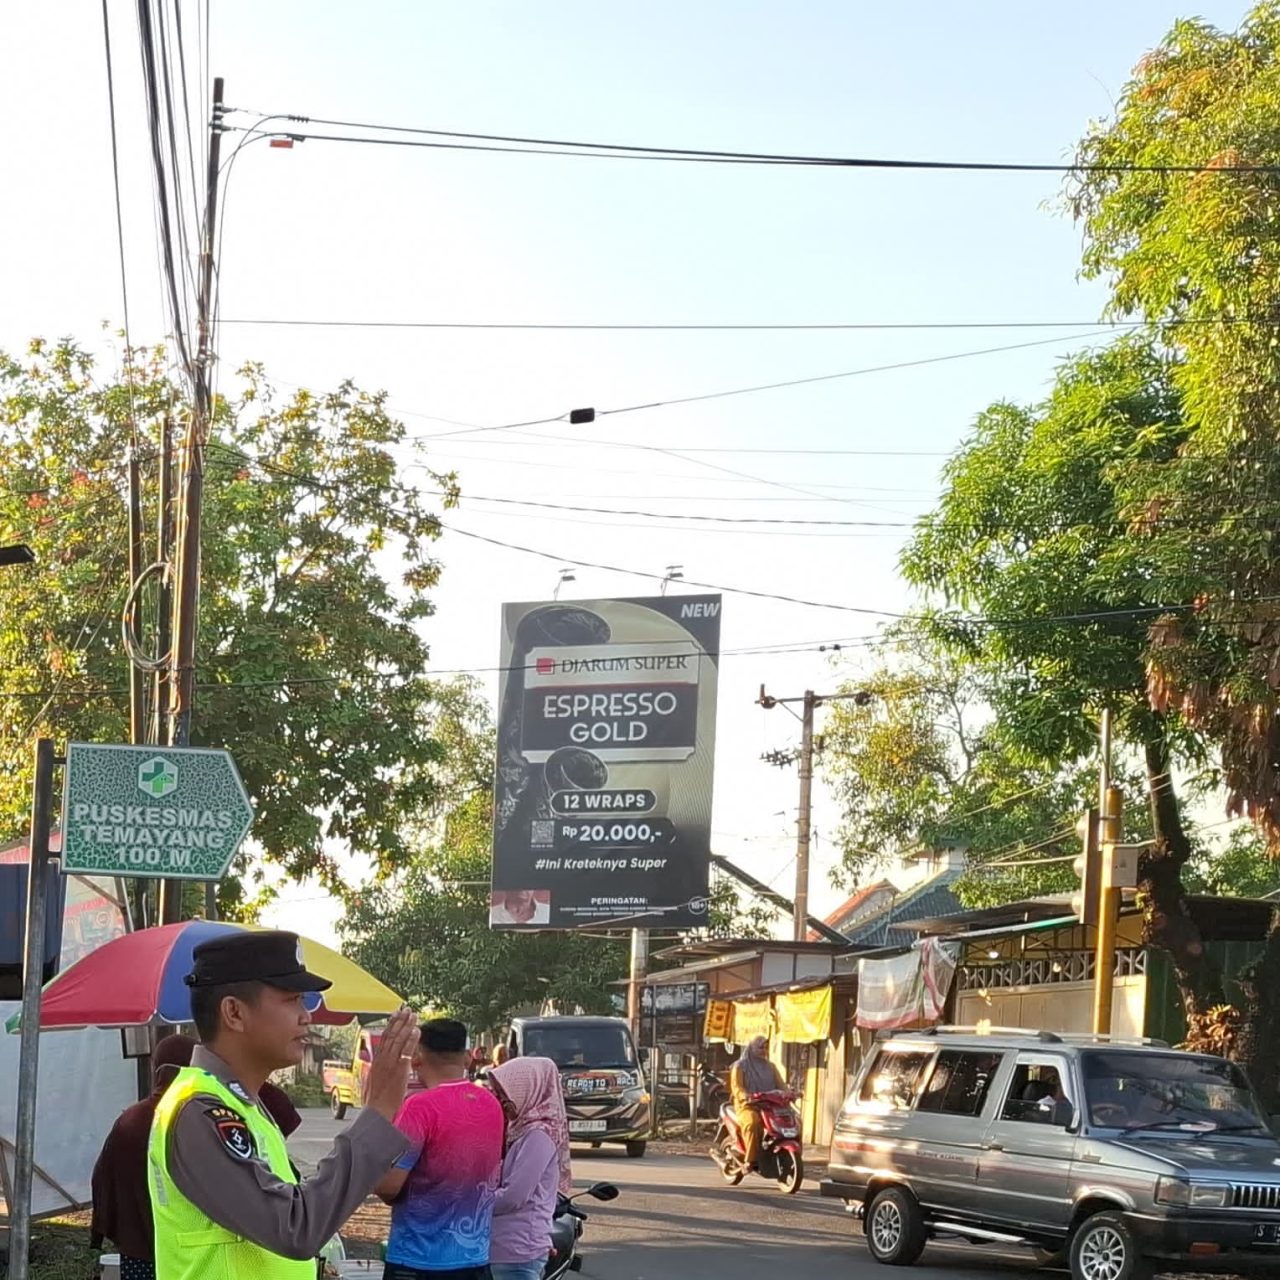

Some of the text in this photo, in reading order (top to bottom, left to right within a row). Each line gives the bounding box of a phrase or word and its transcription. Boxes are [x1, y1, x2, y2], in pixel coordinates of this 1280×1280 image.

[681, 603, 719, 618] NEW
[562, 654, 688, 673] DJARUM SUPER
[543, 692, 677, 718] ESPRESSO
[570, 721, 648, 743] GOLD
[563, 794, 646, 809] 12 WRAPS
[74, 803, 233, 829] PUSKESMAS
[80, 825, 225, 849] TEMAYANG
[562, 824, 662, 843] Rp 20.000,-
[116, 847, 192, 866] 100 M
[535, 858, 667, 872] #Ini Kreteknya Super
[591, 897, 649, 906] PERINGATAN:
[595, 1079, 606, 1088] TO
